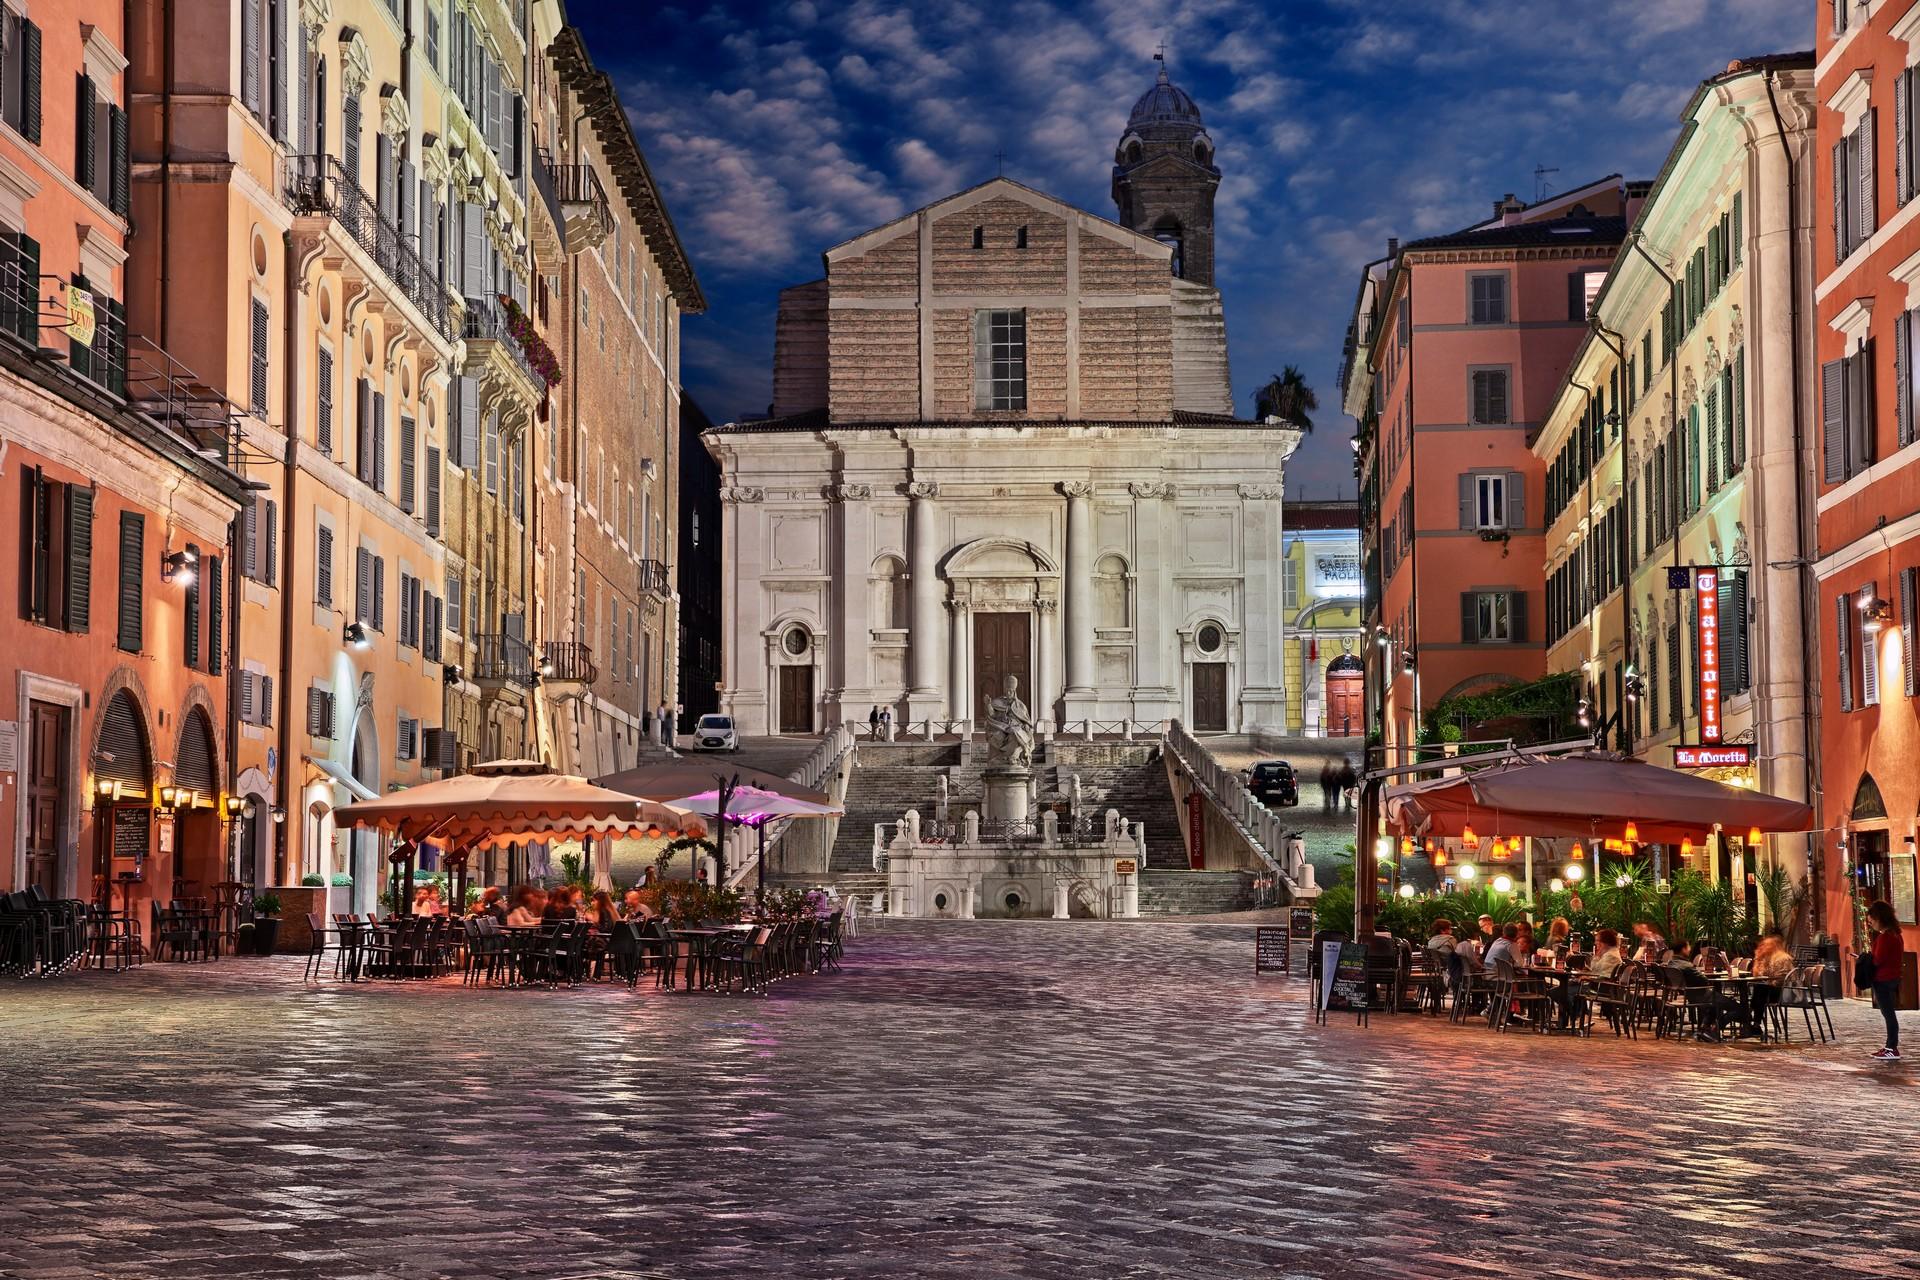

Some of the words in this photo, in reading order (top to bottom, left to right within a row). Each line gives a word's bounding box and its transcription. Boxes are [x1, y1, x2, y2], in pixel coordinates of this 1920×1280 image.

[1698, 573, 1719, 738] Trattoria
[1677, 751, 1695, 763] La
[1698, 751, 1747, 763] Moretta
